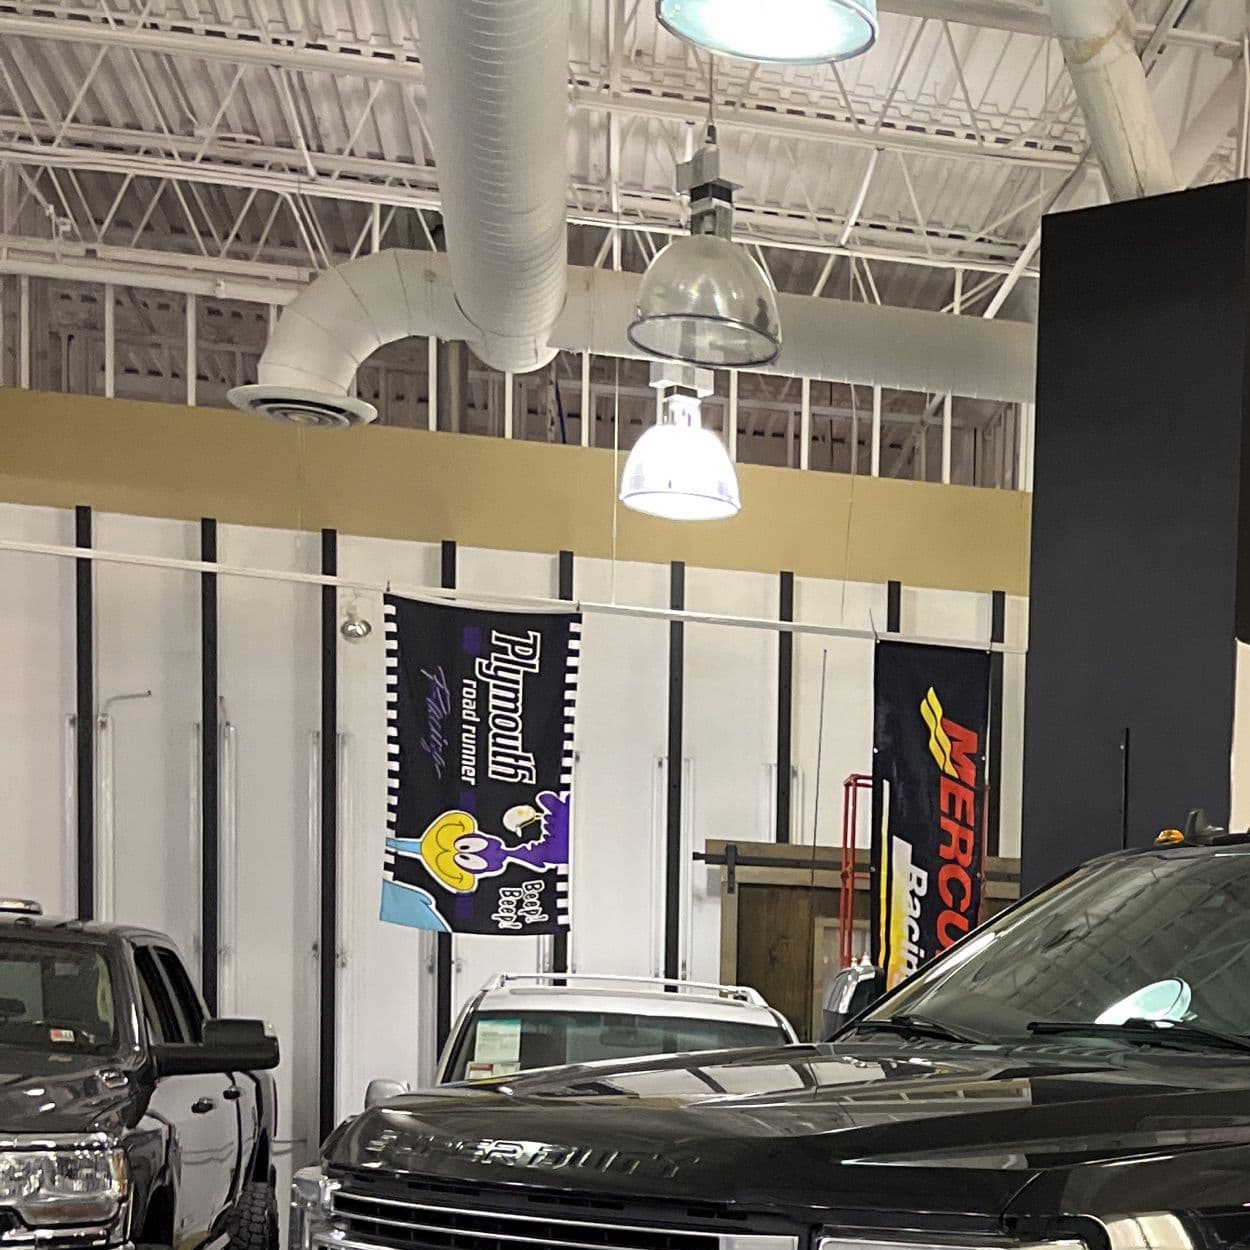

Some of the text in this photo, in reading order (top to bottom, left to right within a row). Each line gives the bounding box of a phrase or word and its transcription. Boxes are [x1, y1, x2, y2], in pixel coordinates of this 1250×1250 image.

[461, 679, 480, 786] road runner
[475, 630, 541, 784] Plymouth
[935, 717, 978, 957] MERCU
[491, 887, 523, 929] Beep!
[517, 880, 549, 924] Beep!
[902, 863, 929, 978] Racin
